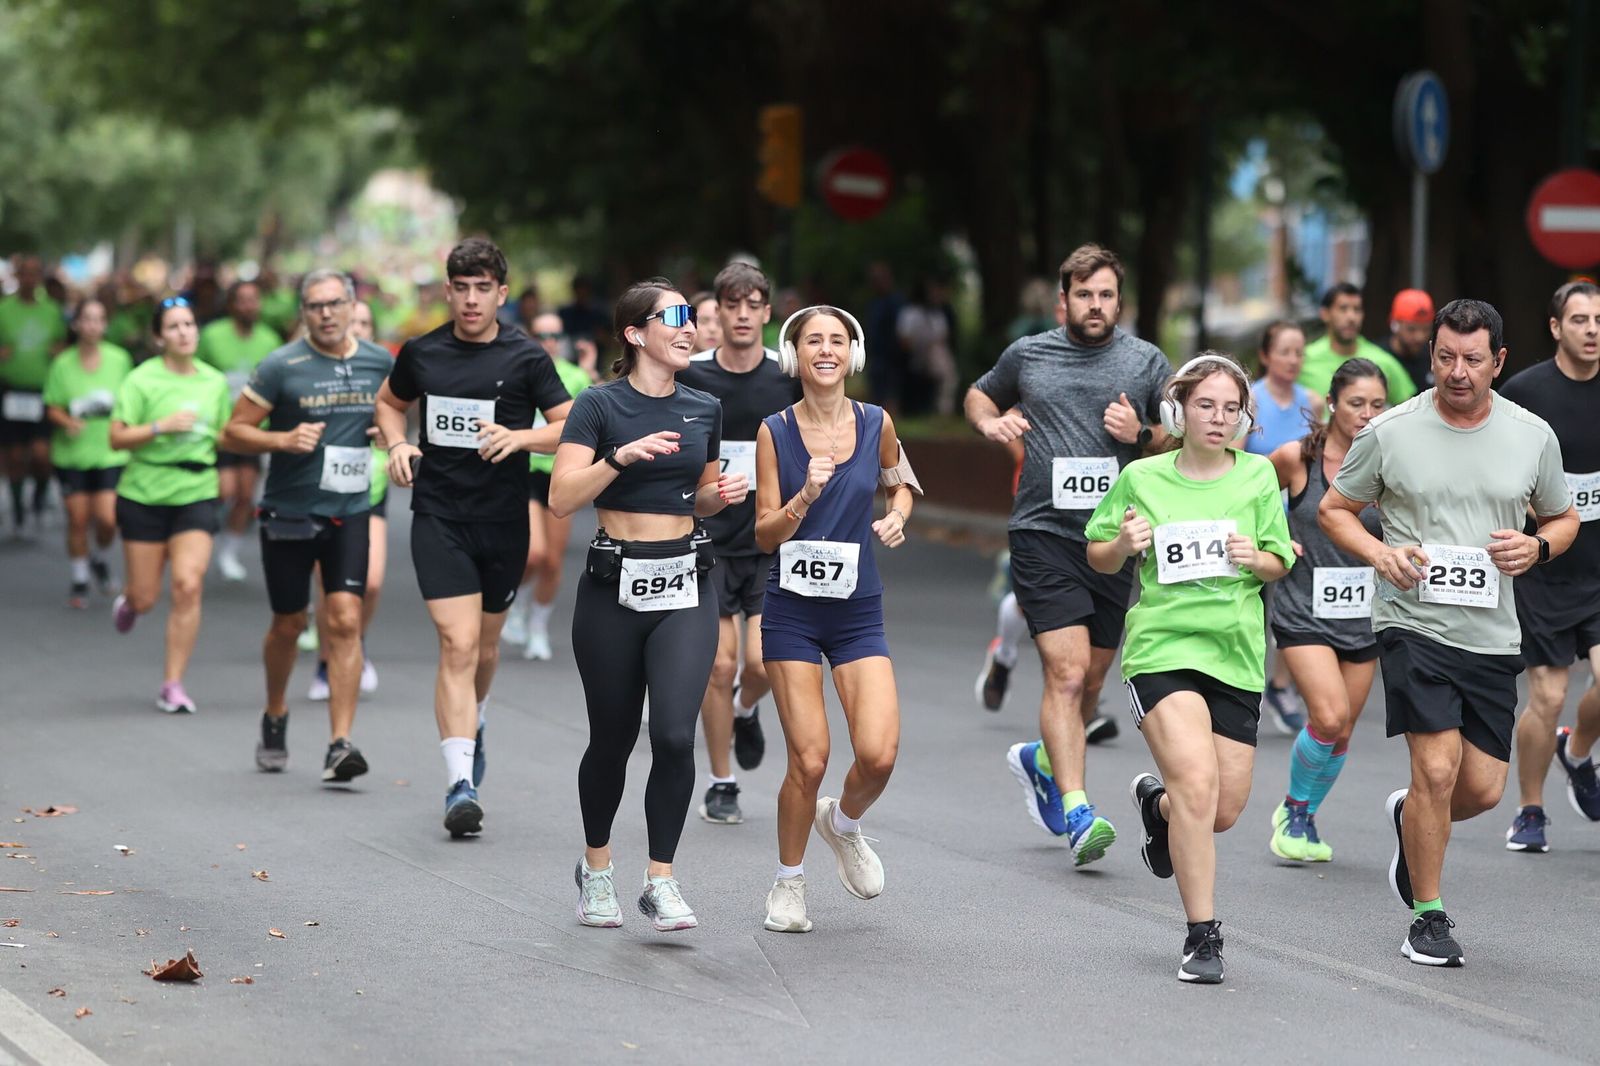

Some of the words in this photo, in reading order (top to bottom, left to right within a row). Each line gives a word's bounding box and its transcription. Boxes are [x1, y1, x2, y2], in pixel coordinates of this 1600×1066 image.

[299, 392, 376, 408] MARBELL
[436, 415, 480, 432] 863
[1063, 476, 1110, 493] 406
[1570, 489, 1600, 507] 95
[1166, 539, 1225, 564] 814
[791, 559, 844, 581] 467
[1429, 565, 1486, 589] 233
[631, 573, 685, 597] 694
[1323, 585, 1365, 603] 941
